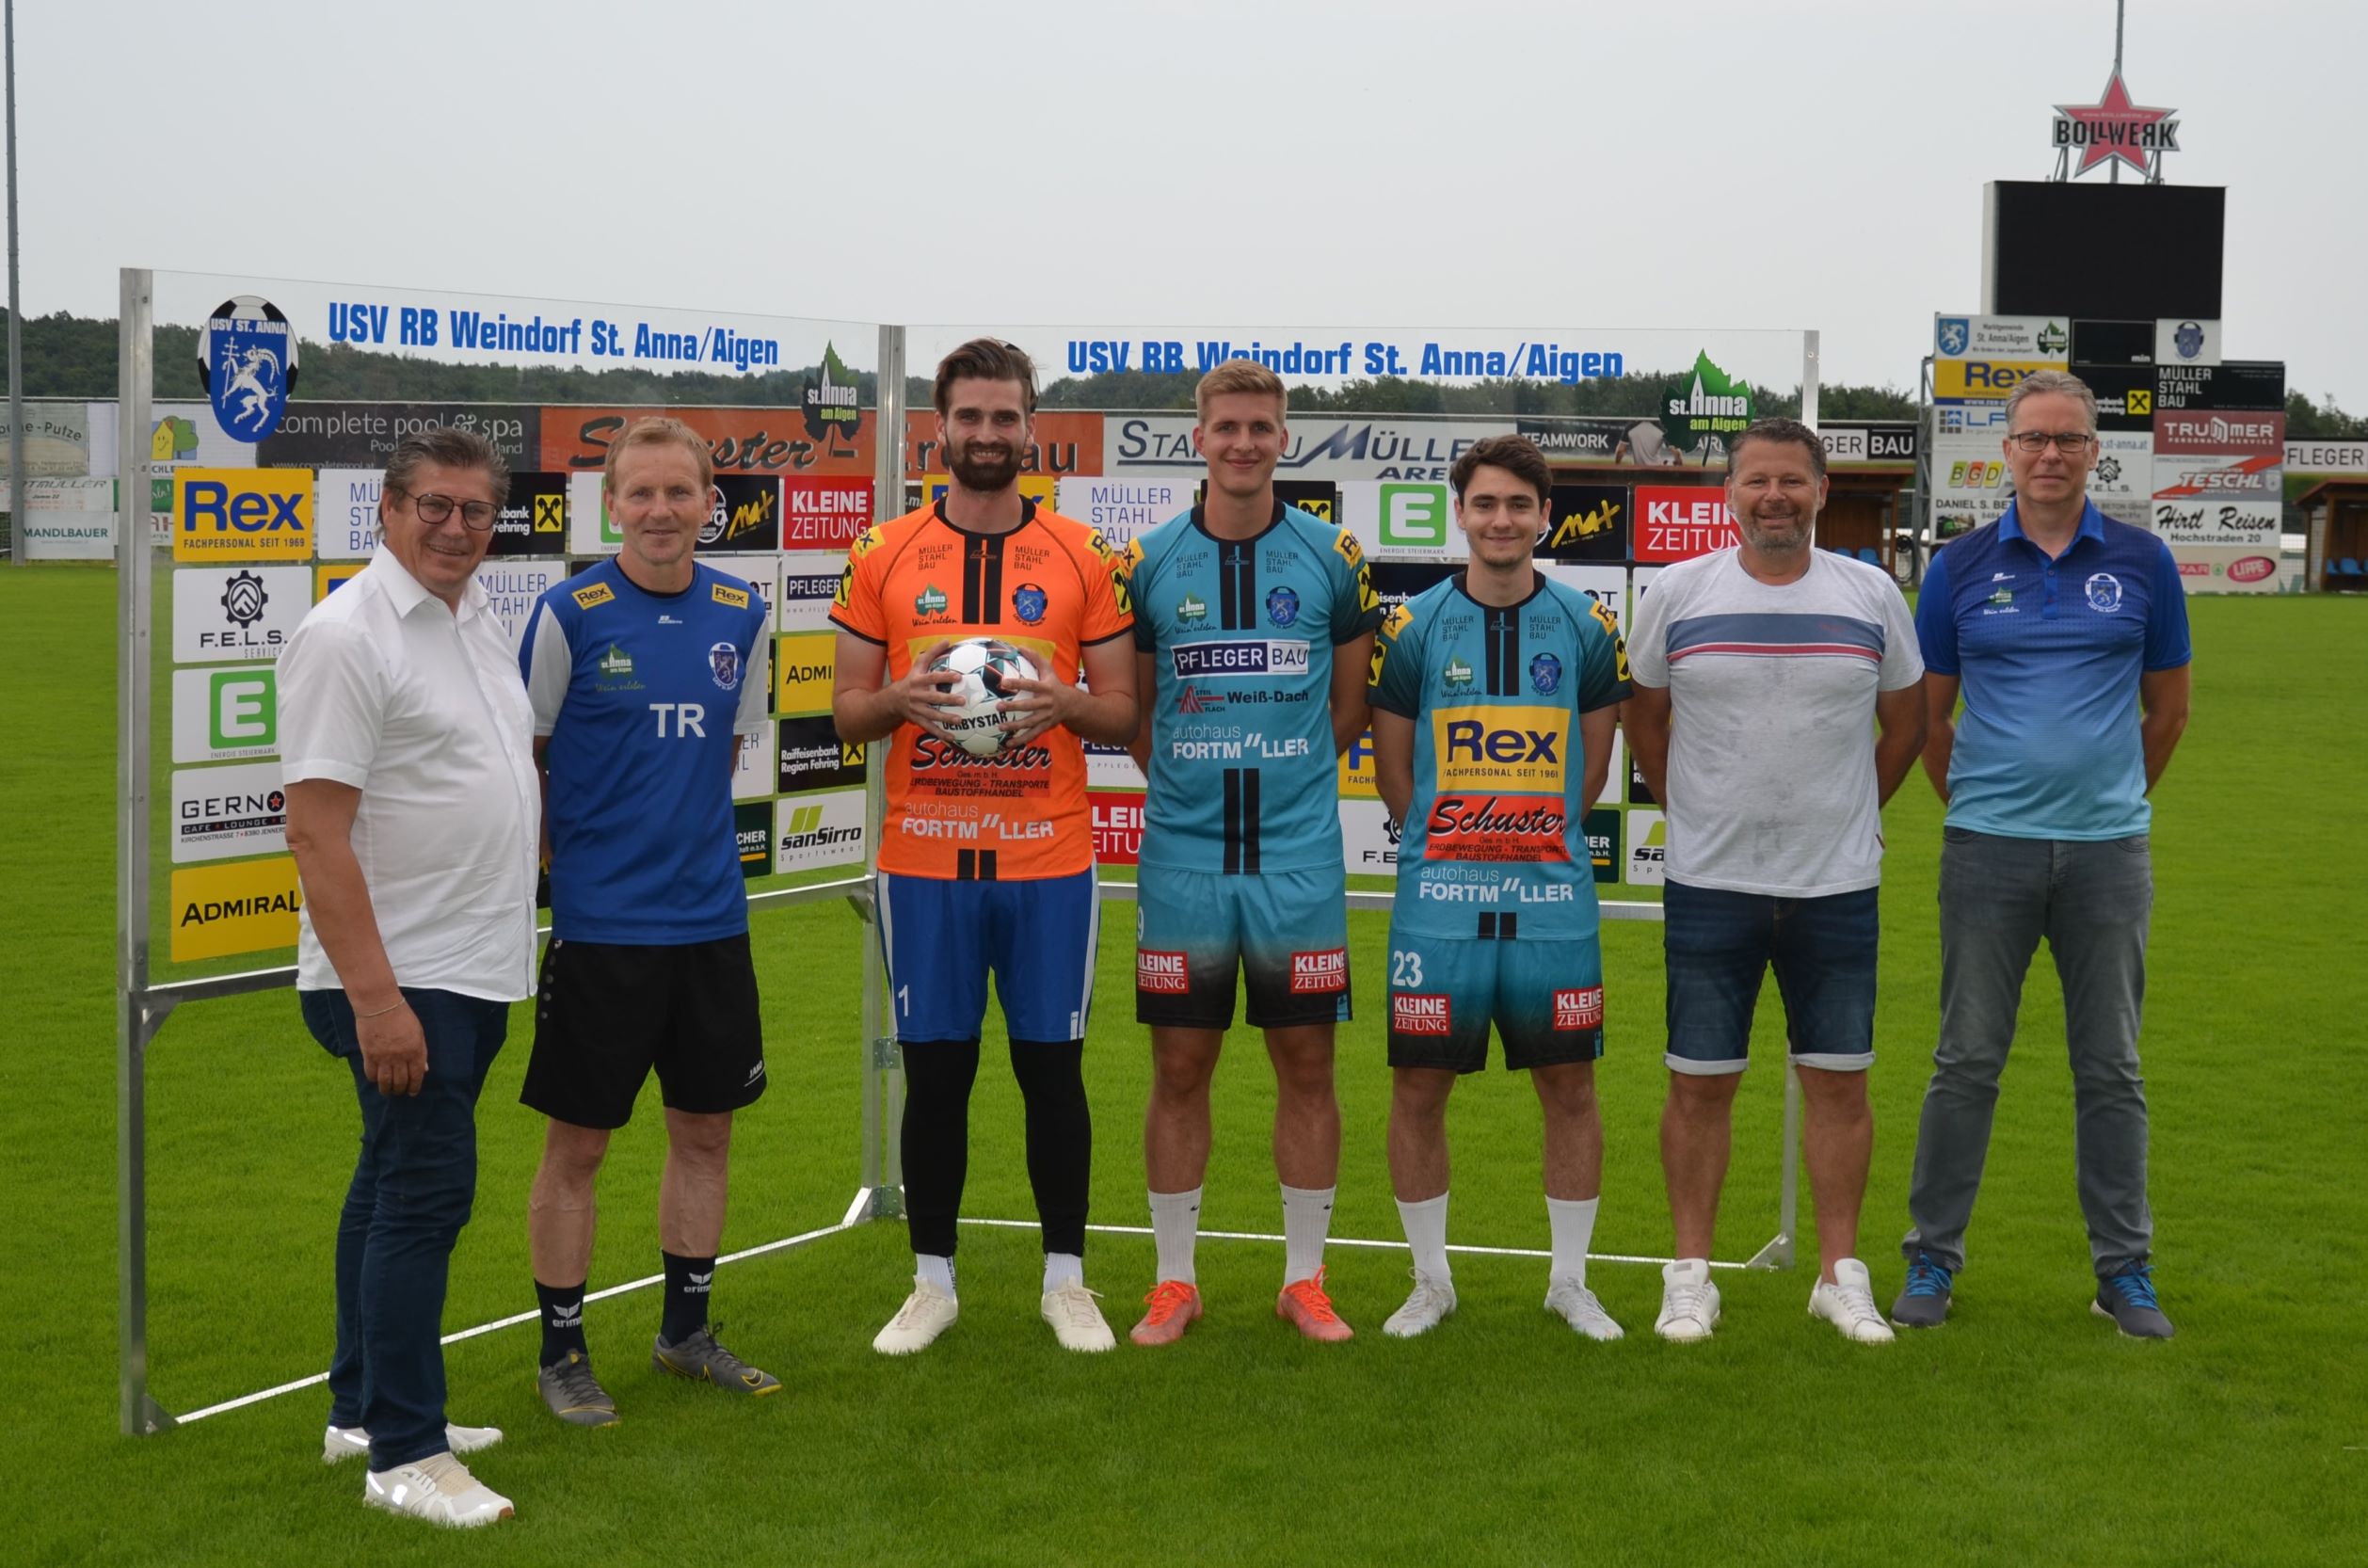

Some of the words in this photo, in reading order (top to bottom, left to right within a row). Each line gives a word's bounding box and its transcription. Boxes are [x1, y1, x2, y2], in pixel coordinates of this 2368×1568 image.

[2056, 120, 2175, 147] BOLLWERK
[211, 318, 232, 331] USV
[236, 319, 254, 333] ST.
[256, 321, 288, 335] ANNA
[329, 302, 390, 344] USV
[400, 307, 439, 347] RB
[450, 311, 582, 355] Weindorf
[591, 320, 624, 357] St.
[633, 323, 778, 371] Anna/Aigen
[1067, 341, 1130, 374] USV
[1143, 342, 1183, 374] RB
[1364, 343, 1408, 376] St.
[1419, 342, 1624, 386] Anna/Aigen
[2159, 366, 2212, 380] MÜLLER
[2158, 381, 2202, 394] STAHL
[2158, 395, 2185, 408] BAU
[820, 408, 834, 421] am
[834, 406, 856, 422] Aigen
[43, 421, 83, 441] Putze
[274, 411, 388, 438] complete
[394, 412, 444, 439] pool
[482, 418, 522, 441] spa
[1690, 418, 1709, 431] am
[1711, 417, 1748, 432] Aigen
[1870, 436, 1913, 455] BAU
[2285, 448, 2364, 466] FLEGER
[1376, 467, 1448, 480] ARE
[2179, 472, 2263, 488] TESCHL
[792, 490, 868, 513] KLEINE
[1091, 483, 1172, 505] MÜLLER
[184, 481, 305, 533] Rex
[1936, 499, 1976, 509] DANIEL
[1091, 507, 1158, 524] STAHL
[2155, 504, 2205, 530] Hirtl
[2218, 505, 2276, 531] Reisen
[24, 528, 108, 538] MANDLBAUER
[792, 517, 868, 540] ZEITUNG
[184, 538, 256, 549] FACHPERSONAL
[260, 537, 280, 548] SEIT
[284, 537, 306, 548] 1969
[2170, 533, 2244, 543] Hochstraden
[2248, 534, 2262, 543] 20
[918, 543, 953, 555] MÜLLER
[1015, 546, 1050, 558] MÜLLER
[1266, 550, 1299, 560] MÜLLER
[918, 552, 947, 564] STAHL
[1015, 553, 1044, 565] STAHL
[1176, 552, 1208, 564] MÜLLER
[1176, 561, 1203, 571] STAHL
[1266, 557, 1292, 567] STAHL
[918, 562, 936, 571] BAU
[1014, 562, 1032, 571] BAU
[1176, 569, 1193, 579] BAU
[1266, 566, 1284, 574] BAU
[2178, 564, 2209, 576] PAR
[577, 584, 608, 603] Rex
[714, 586, 745, 603] Rex
[789, 579, 840, 595] PFLEGER
[1442, 616, 1475, 625] MÜLLER
[1442, 624, 1469, 633] STAHL
[1528, 616, 1561, 625] MÜLLER
[1528, 624, 1556, 632] STAHL
[200, 630, 288, 648] F.E.L.S.
[1442, 632, 1460, 642] BAU
[1528, 632, 1547, 640] BAU
[1176, 647, 1263, 670] PFLEGER
[1272, 648, 1307, 666] BAU
[786, 664, 832, 685] ADMI
[1226, 689, 1309, 704] Weiß-Dach
[649, 703, 706, 738] TR
[1173, 723, 1241, 739] autohaus
[1447, 720, 1559, 764] Rex
[210, 750, 236, 760] ENERGIE
[238, 747, 276, 758] STEIERMARK
[780, 744, 840, 762] Raiffeisenbank
[780, 760, 809, 776] Region
[810, 758, 840, 772] Fehring
[1516, 768, 1536, 778] SEIT
[989, 779, 1050, 790] TRANSPORTE
[935, 788, 1024, 798] BAUSTOFFHANDEL
[904, 801, 979, 818] autohaus
[1429, 796, 1567, 837] Schuster
[184, 824, 212, 834] CAFE
[224, 818, 268, 829] LOUNGE
[181, 832, 234, 843] KIRCHENSTRASSE
[780, 825, 862, 851] sanSirro
[1455, 852, 1543, 862] BAUSTOFFHANDEL
[1420, 866, 1499, 882] autohaus
[181, 889, 299, 927] ADMIRAL
[1392, 950, 1423, 987] 23
[897, 984, 908, 1017] 1
[1394, 995, 1447, 1015] KLEINE
[1394, 1016, 1447, 1032] ZEITUNG
